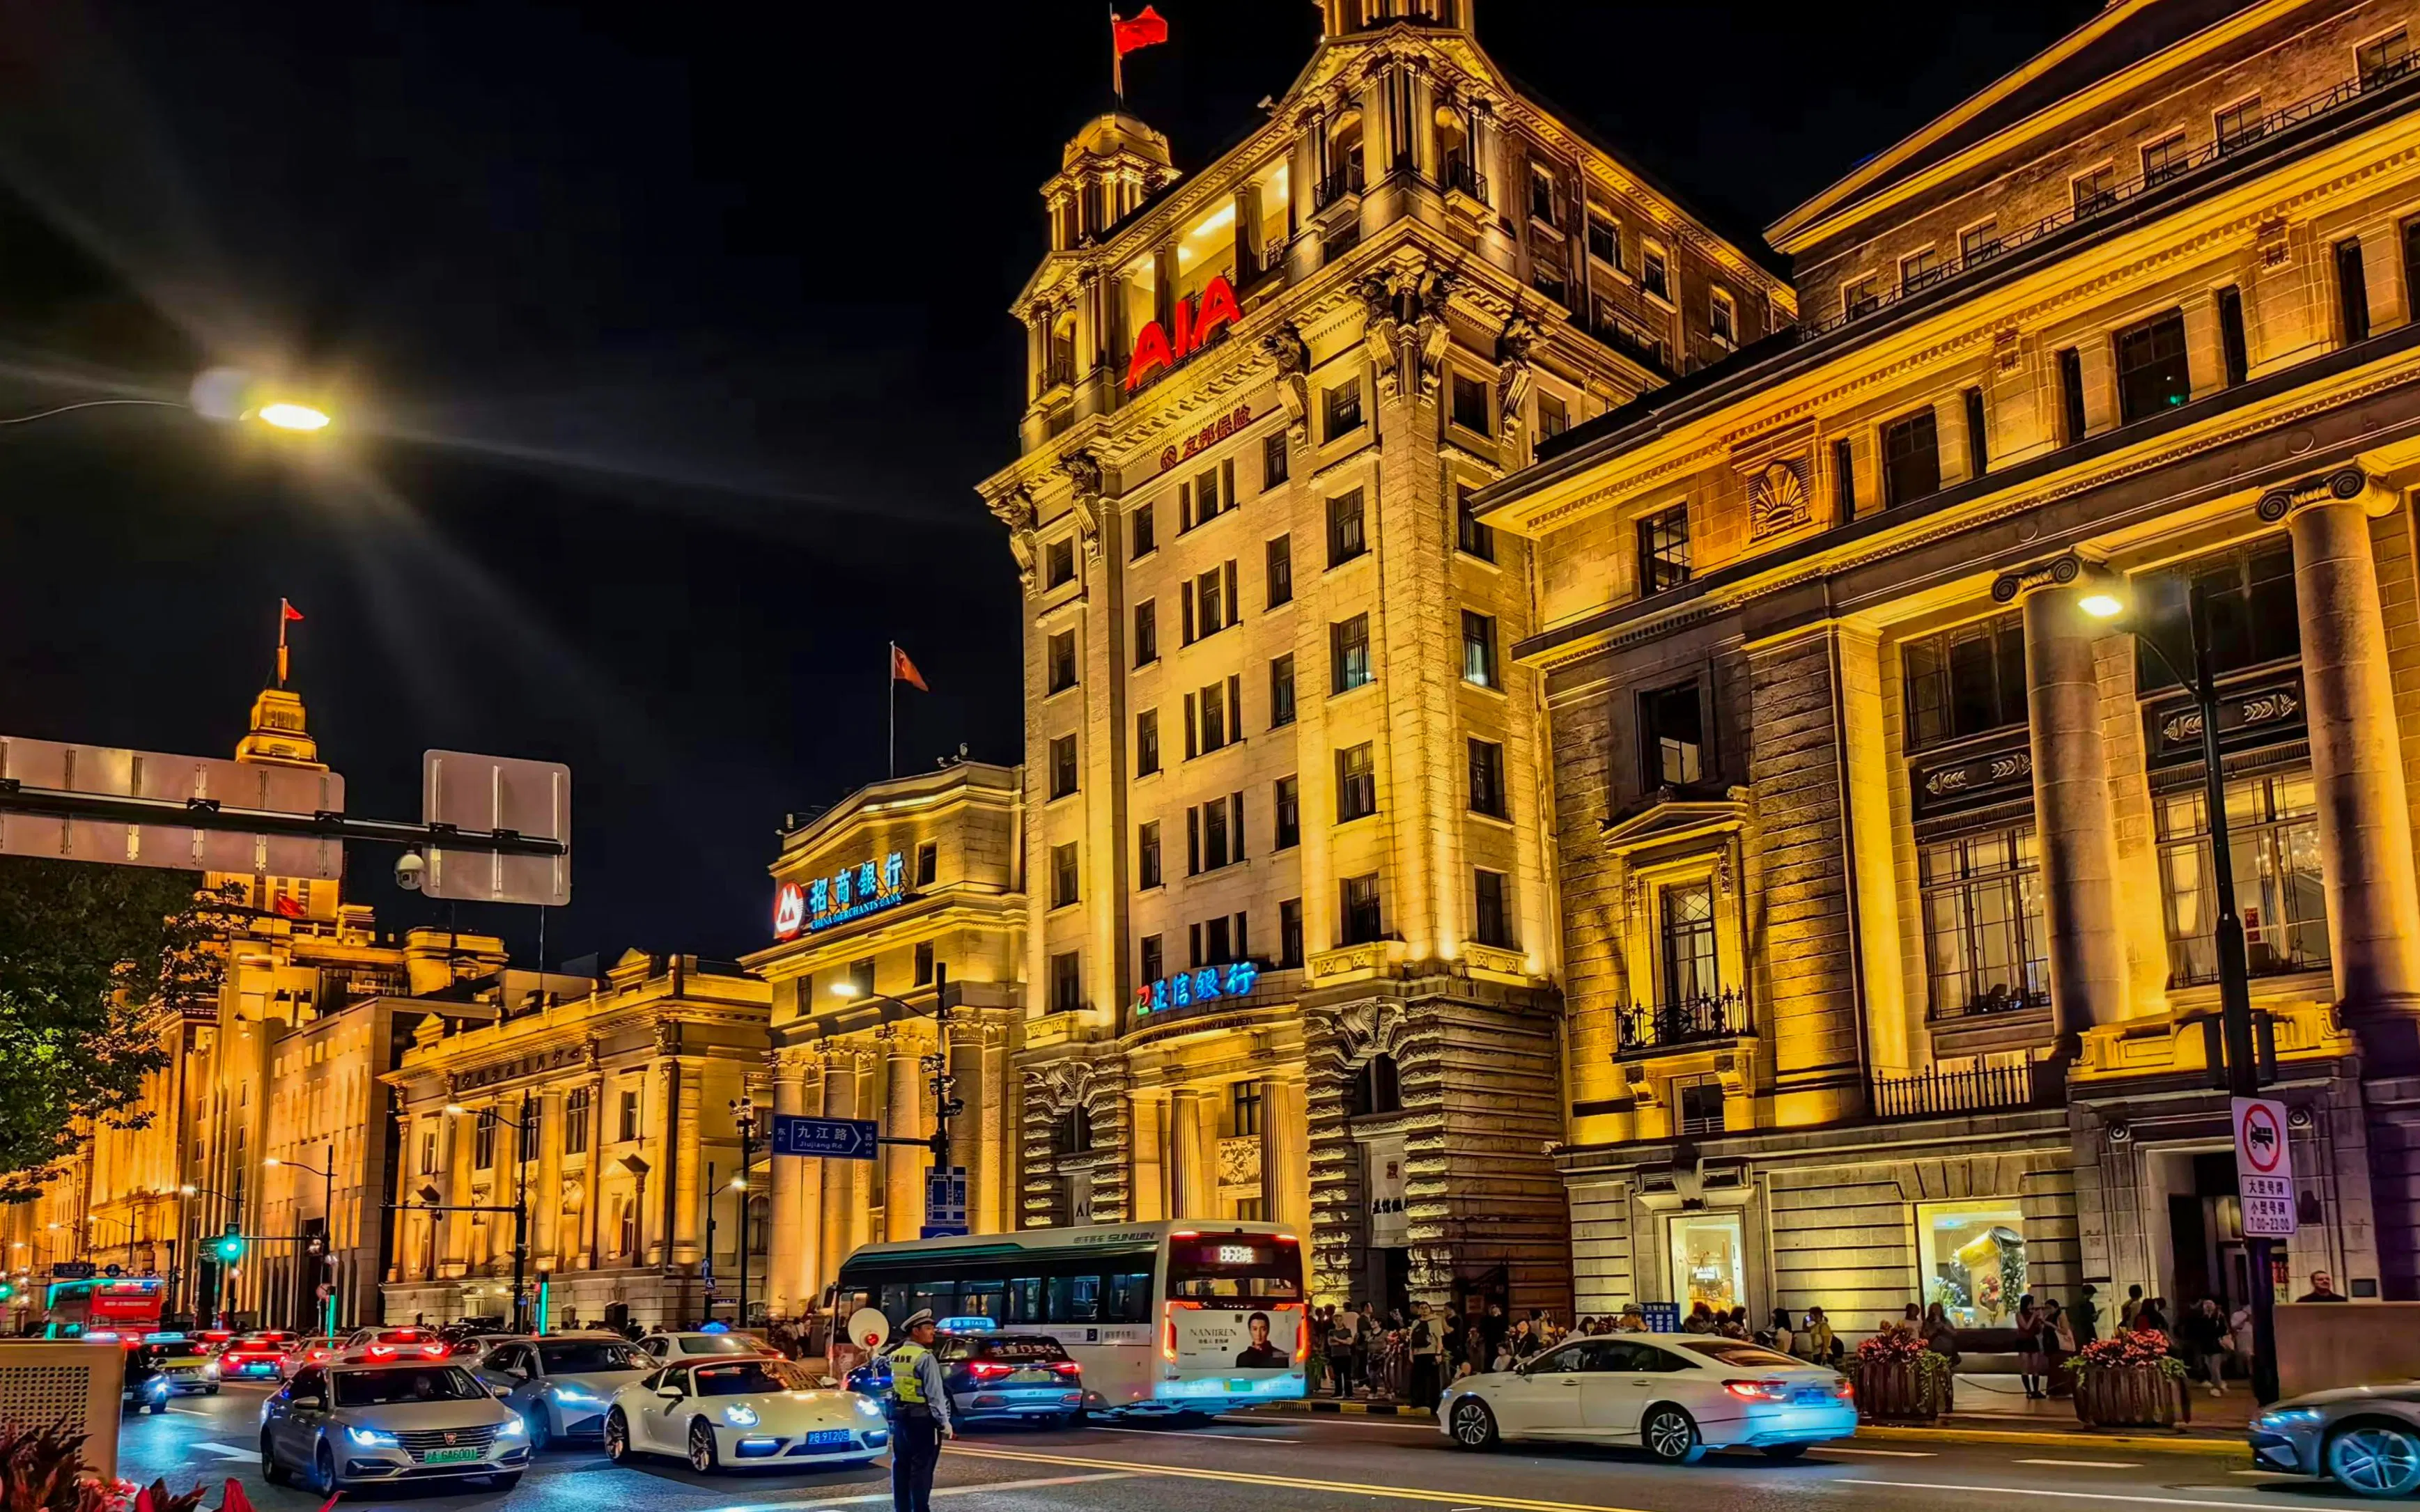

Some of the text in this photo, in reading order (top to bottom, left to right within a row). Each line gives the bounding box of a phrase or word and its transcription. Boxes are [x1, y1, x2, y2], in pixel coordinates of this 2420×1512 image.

[1126, 275, 1241, 391] AIA
[810, 852, 903, 914] 招商银行
[810, 891, 903, 930] CHINA MERCHANTS BANK
[798, 1125, 847, 1141] 九江路
[2249, 1180, 2284, 1195] 大型号牌
[2251, 1201, 2286, 1215] 小型号牌
